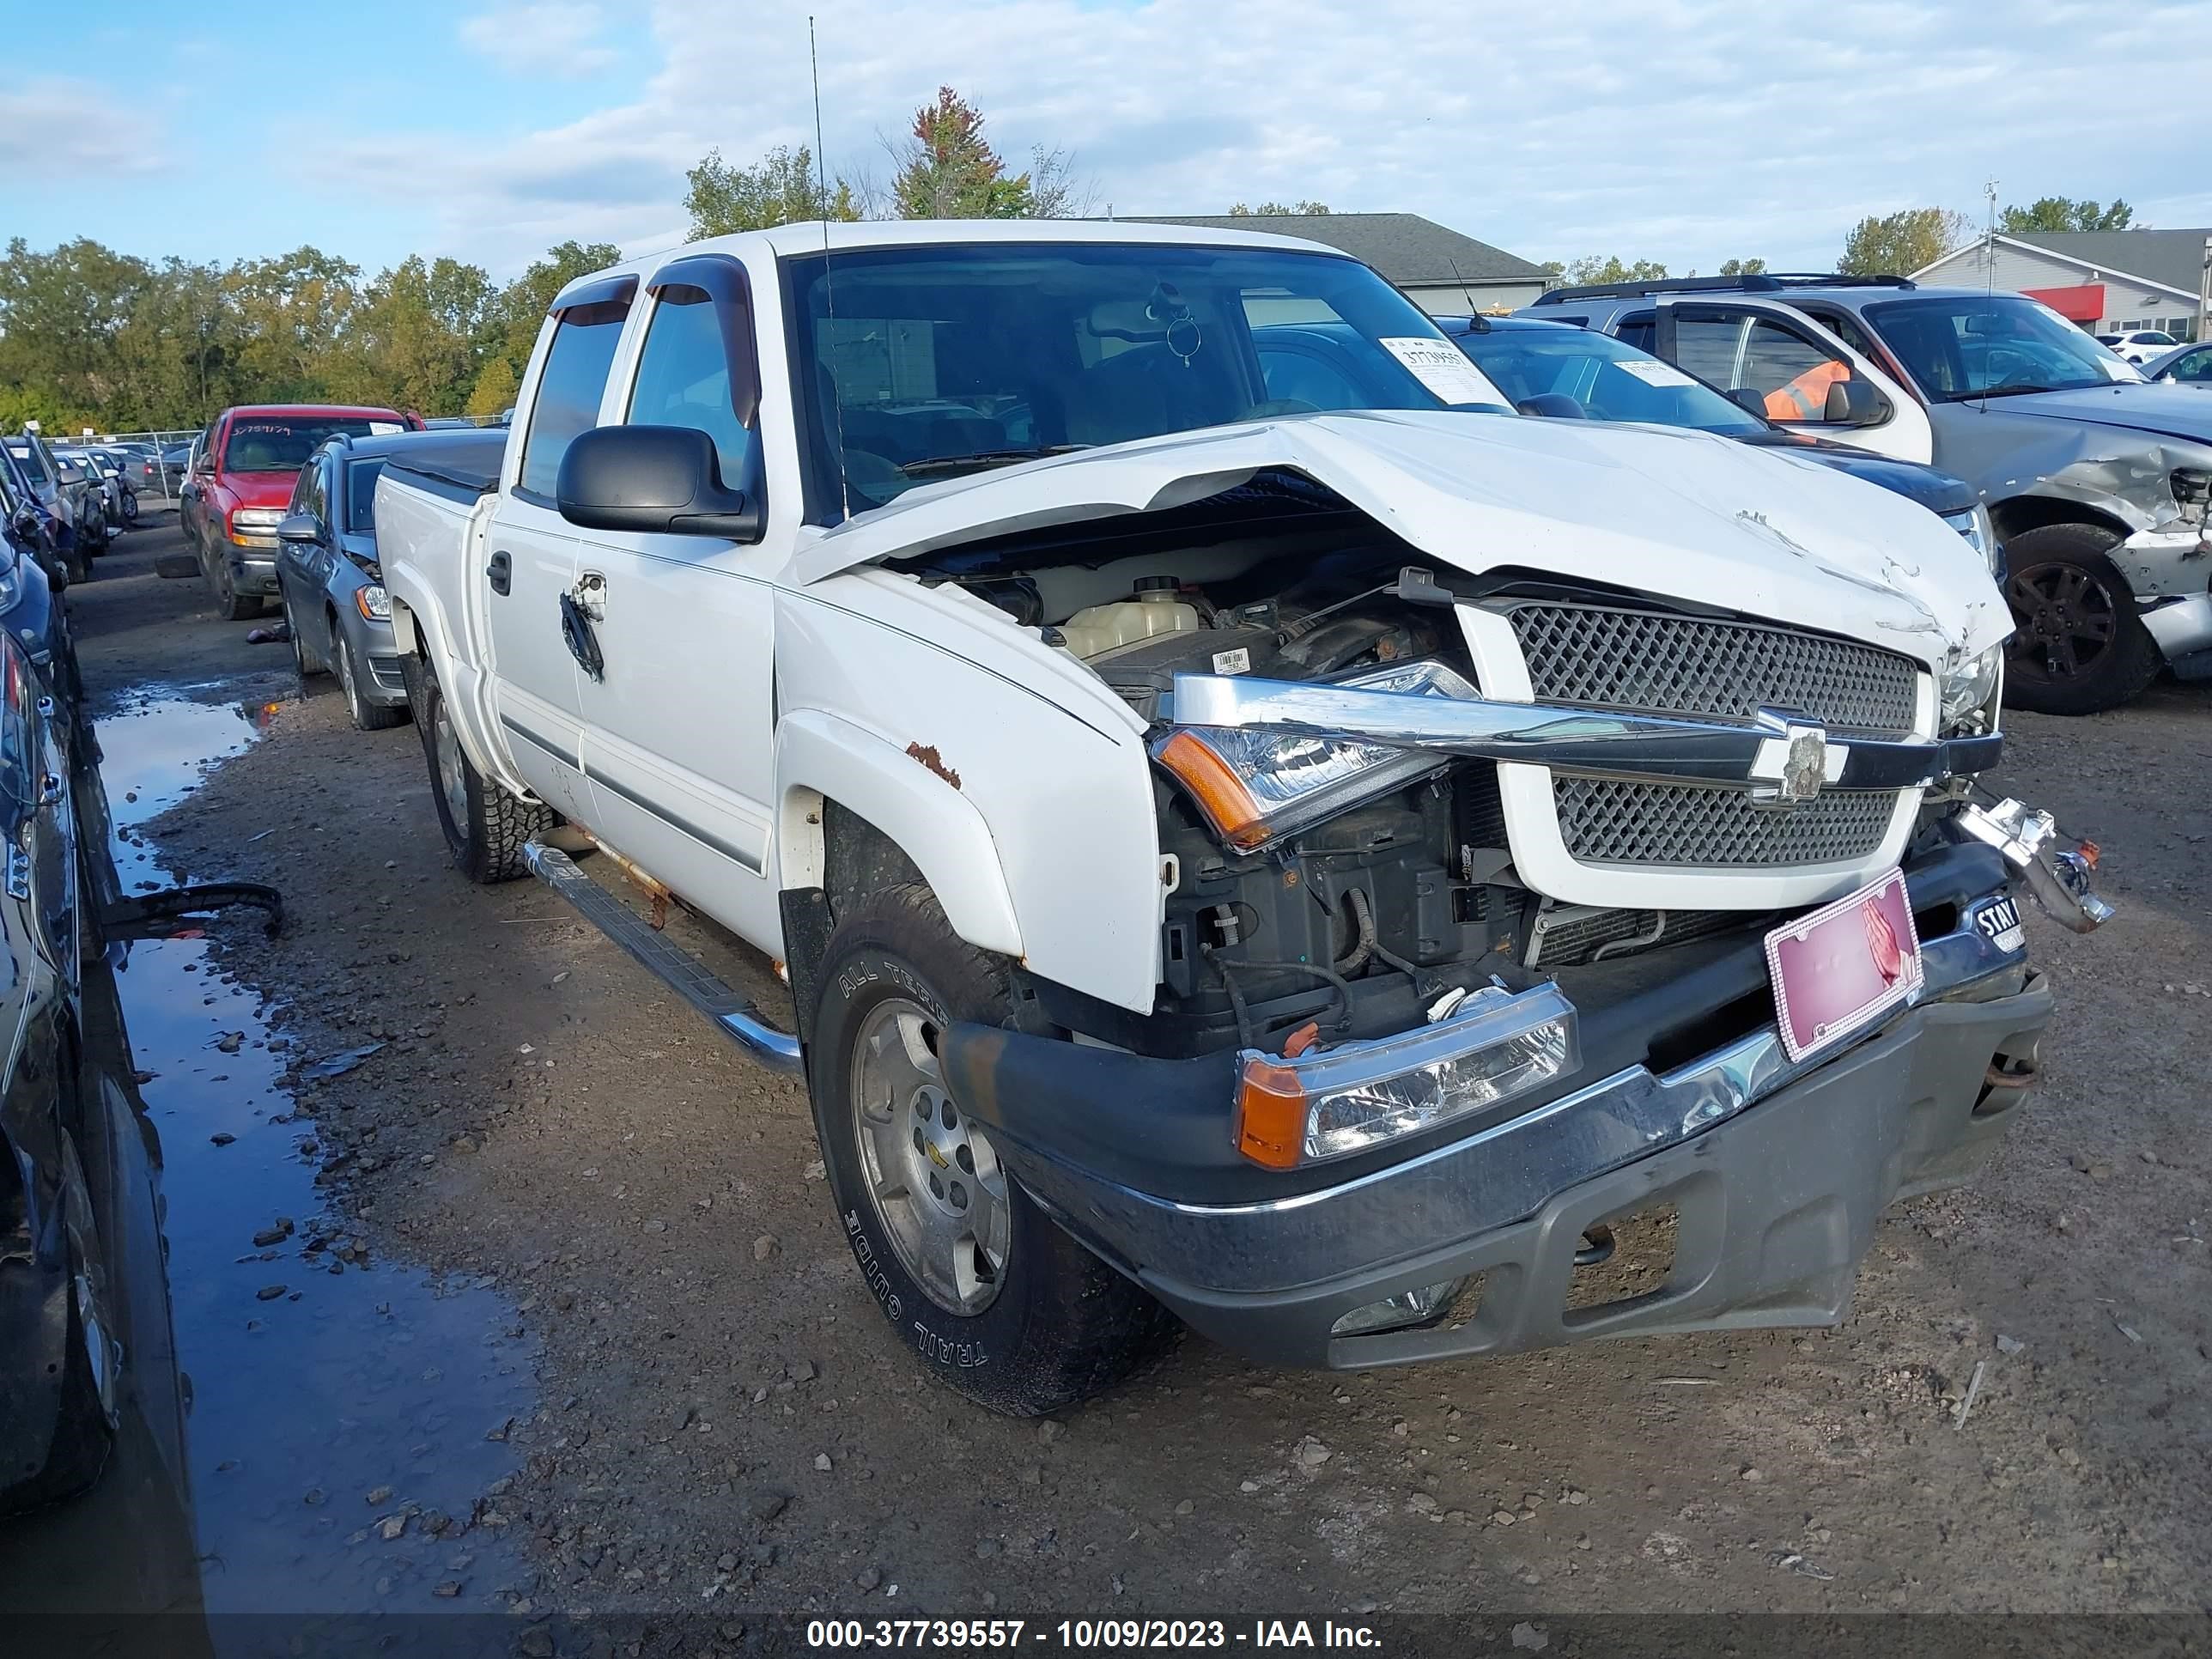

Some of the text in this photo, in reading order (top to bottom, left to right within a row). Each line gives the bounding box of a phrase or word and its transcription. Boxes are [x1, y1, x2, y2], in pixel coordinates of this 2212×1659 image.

[1402, 350, 1467, 366] 37739557
[1978, 900, 2015, 937] STAY
[838, 961, 878, 999] ALL
[844, 1209, 989, 1367] TRAIL GUIDE
